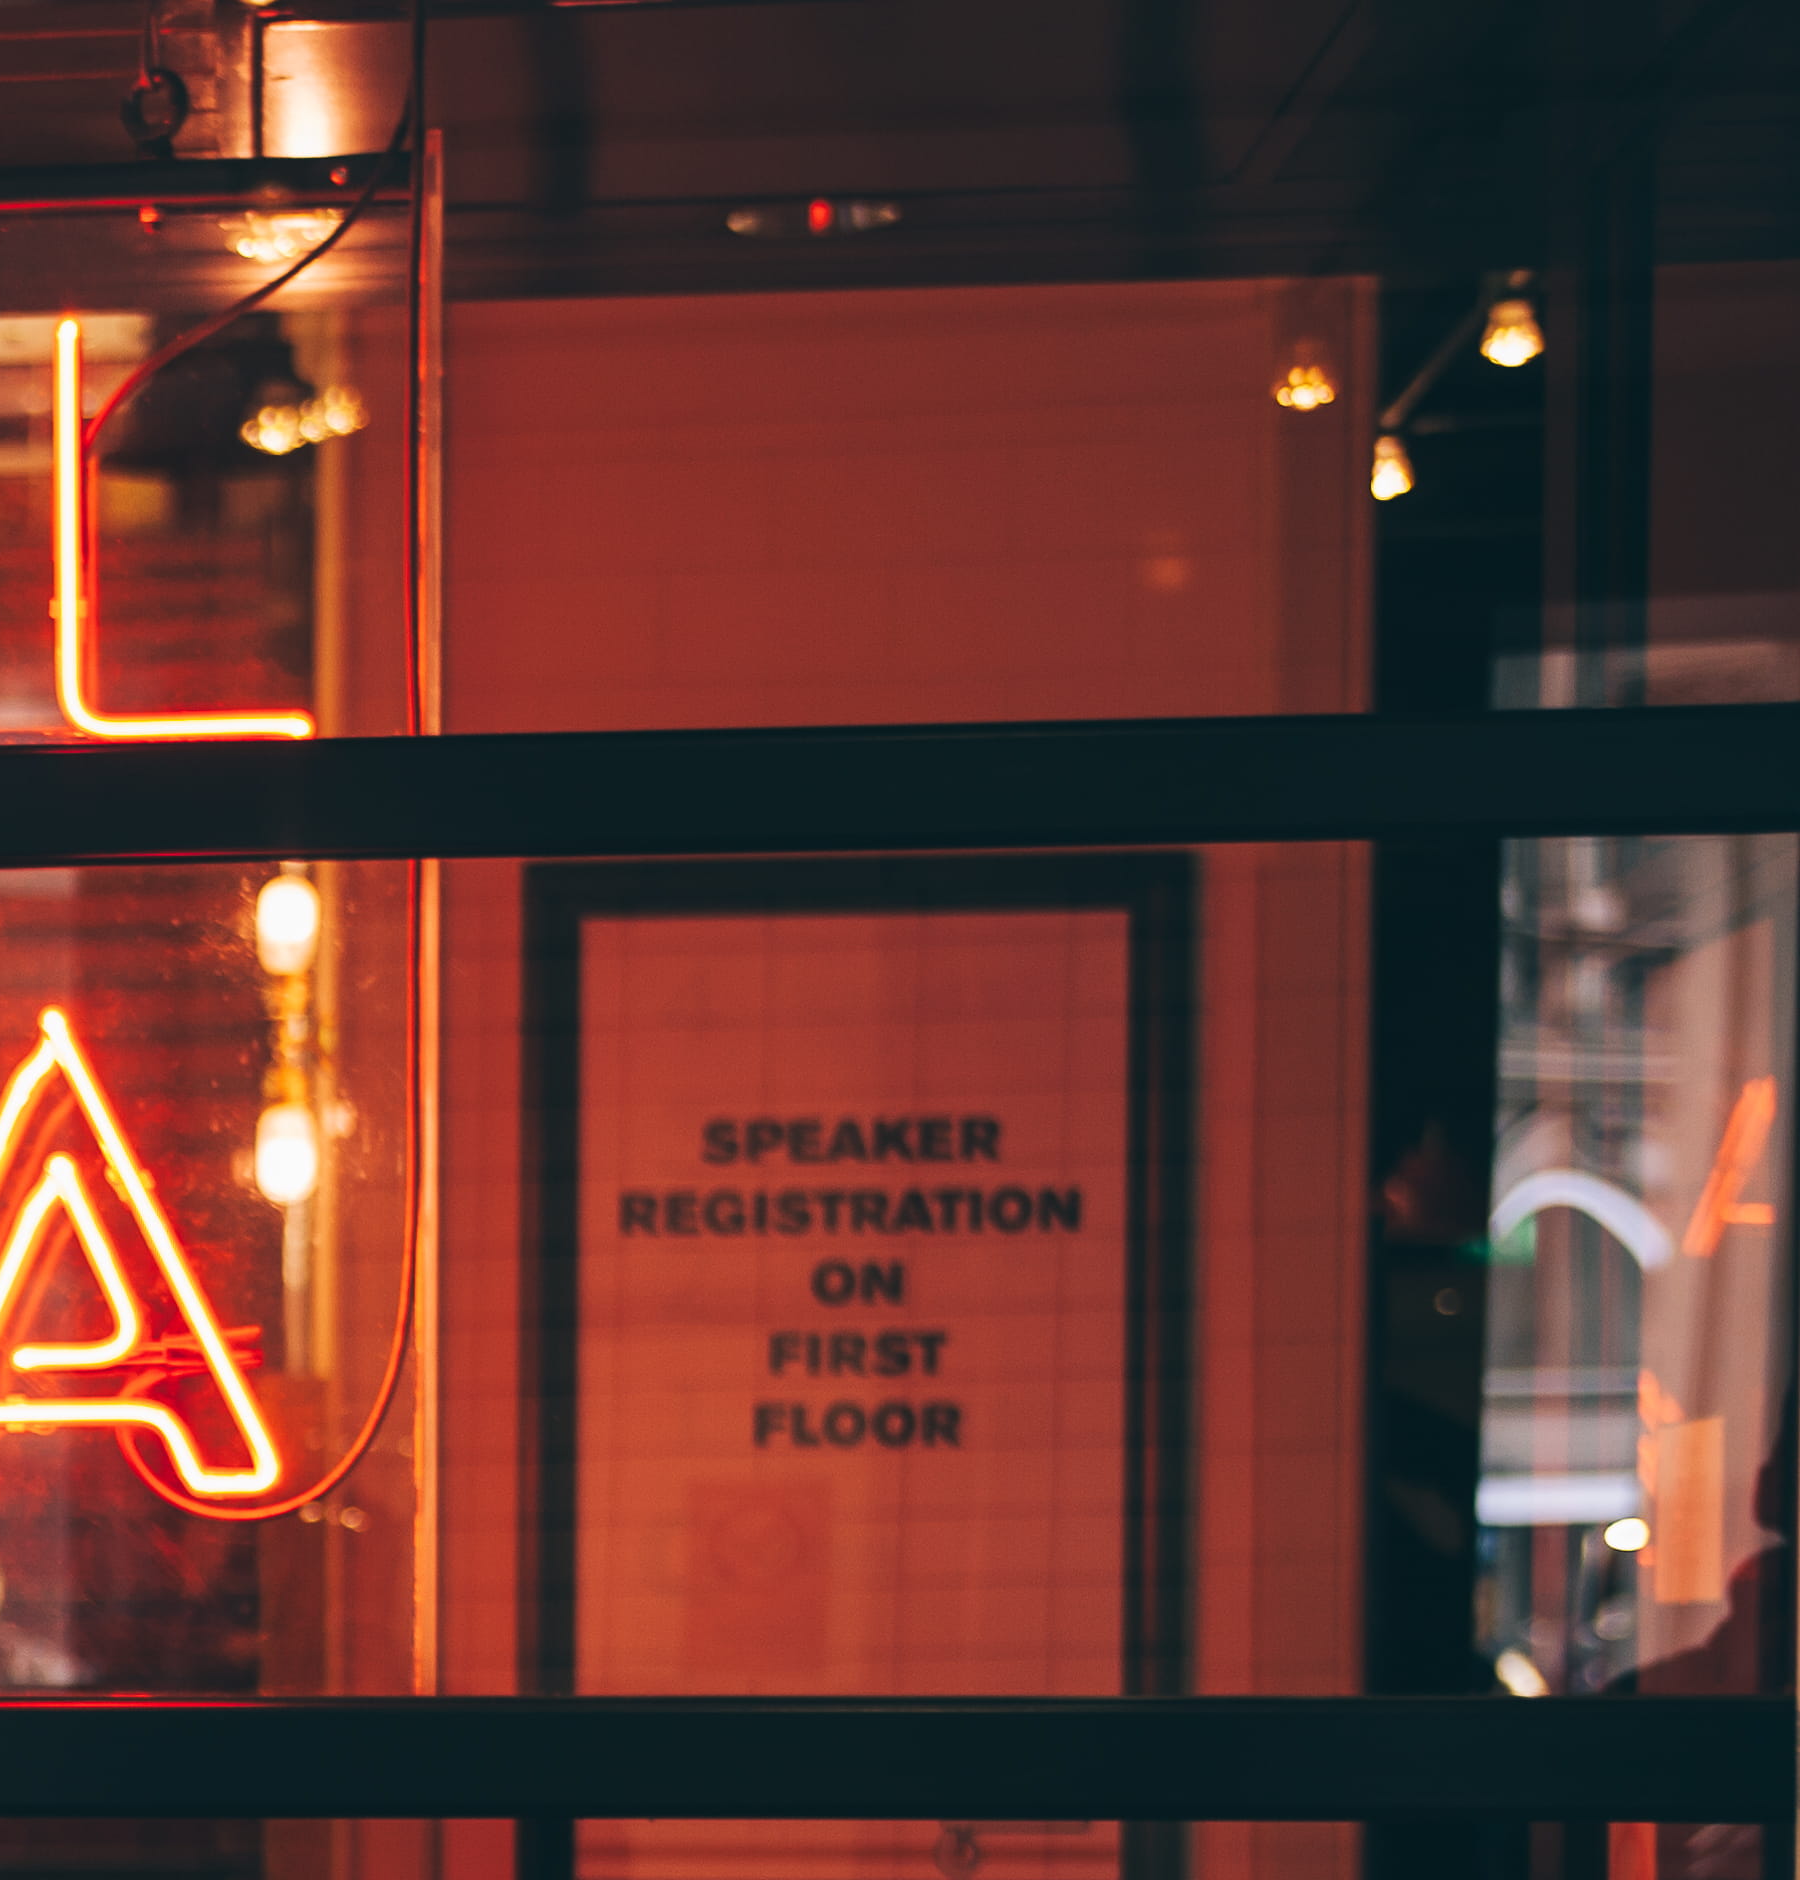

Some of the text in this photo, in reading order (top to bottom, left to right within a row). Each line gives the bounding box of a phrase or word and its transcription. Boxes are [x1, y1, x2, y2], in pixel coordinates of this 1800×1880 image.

[700, 1116, 1002, 1166] SPEAKER
[616, 1184, 1084, 1238] REGISTRATION
[810, 1259, 905, 1306] ON
[767, 1329, 949, 1377] FIRST
[751, 1401, 964, 1450] FLOOR
